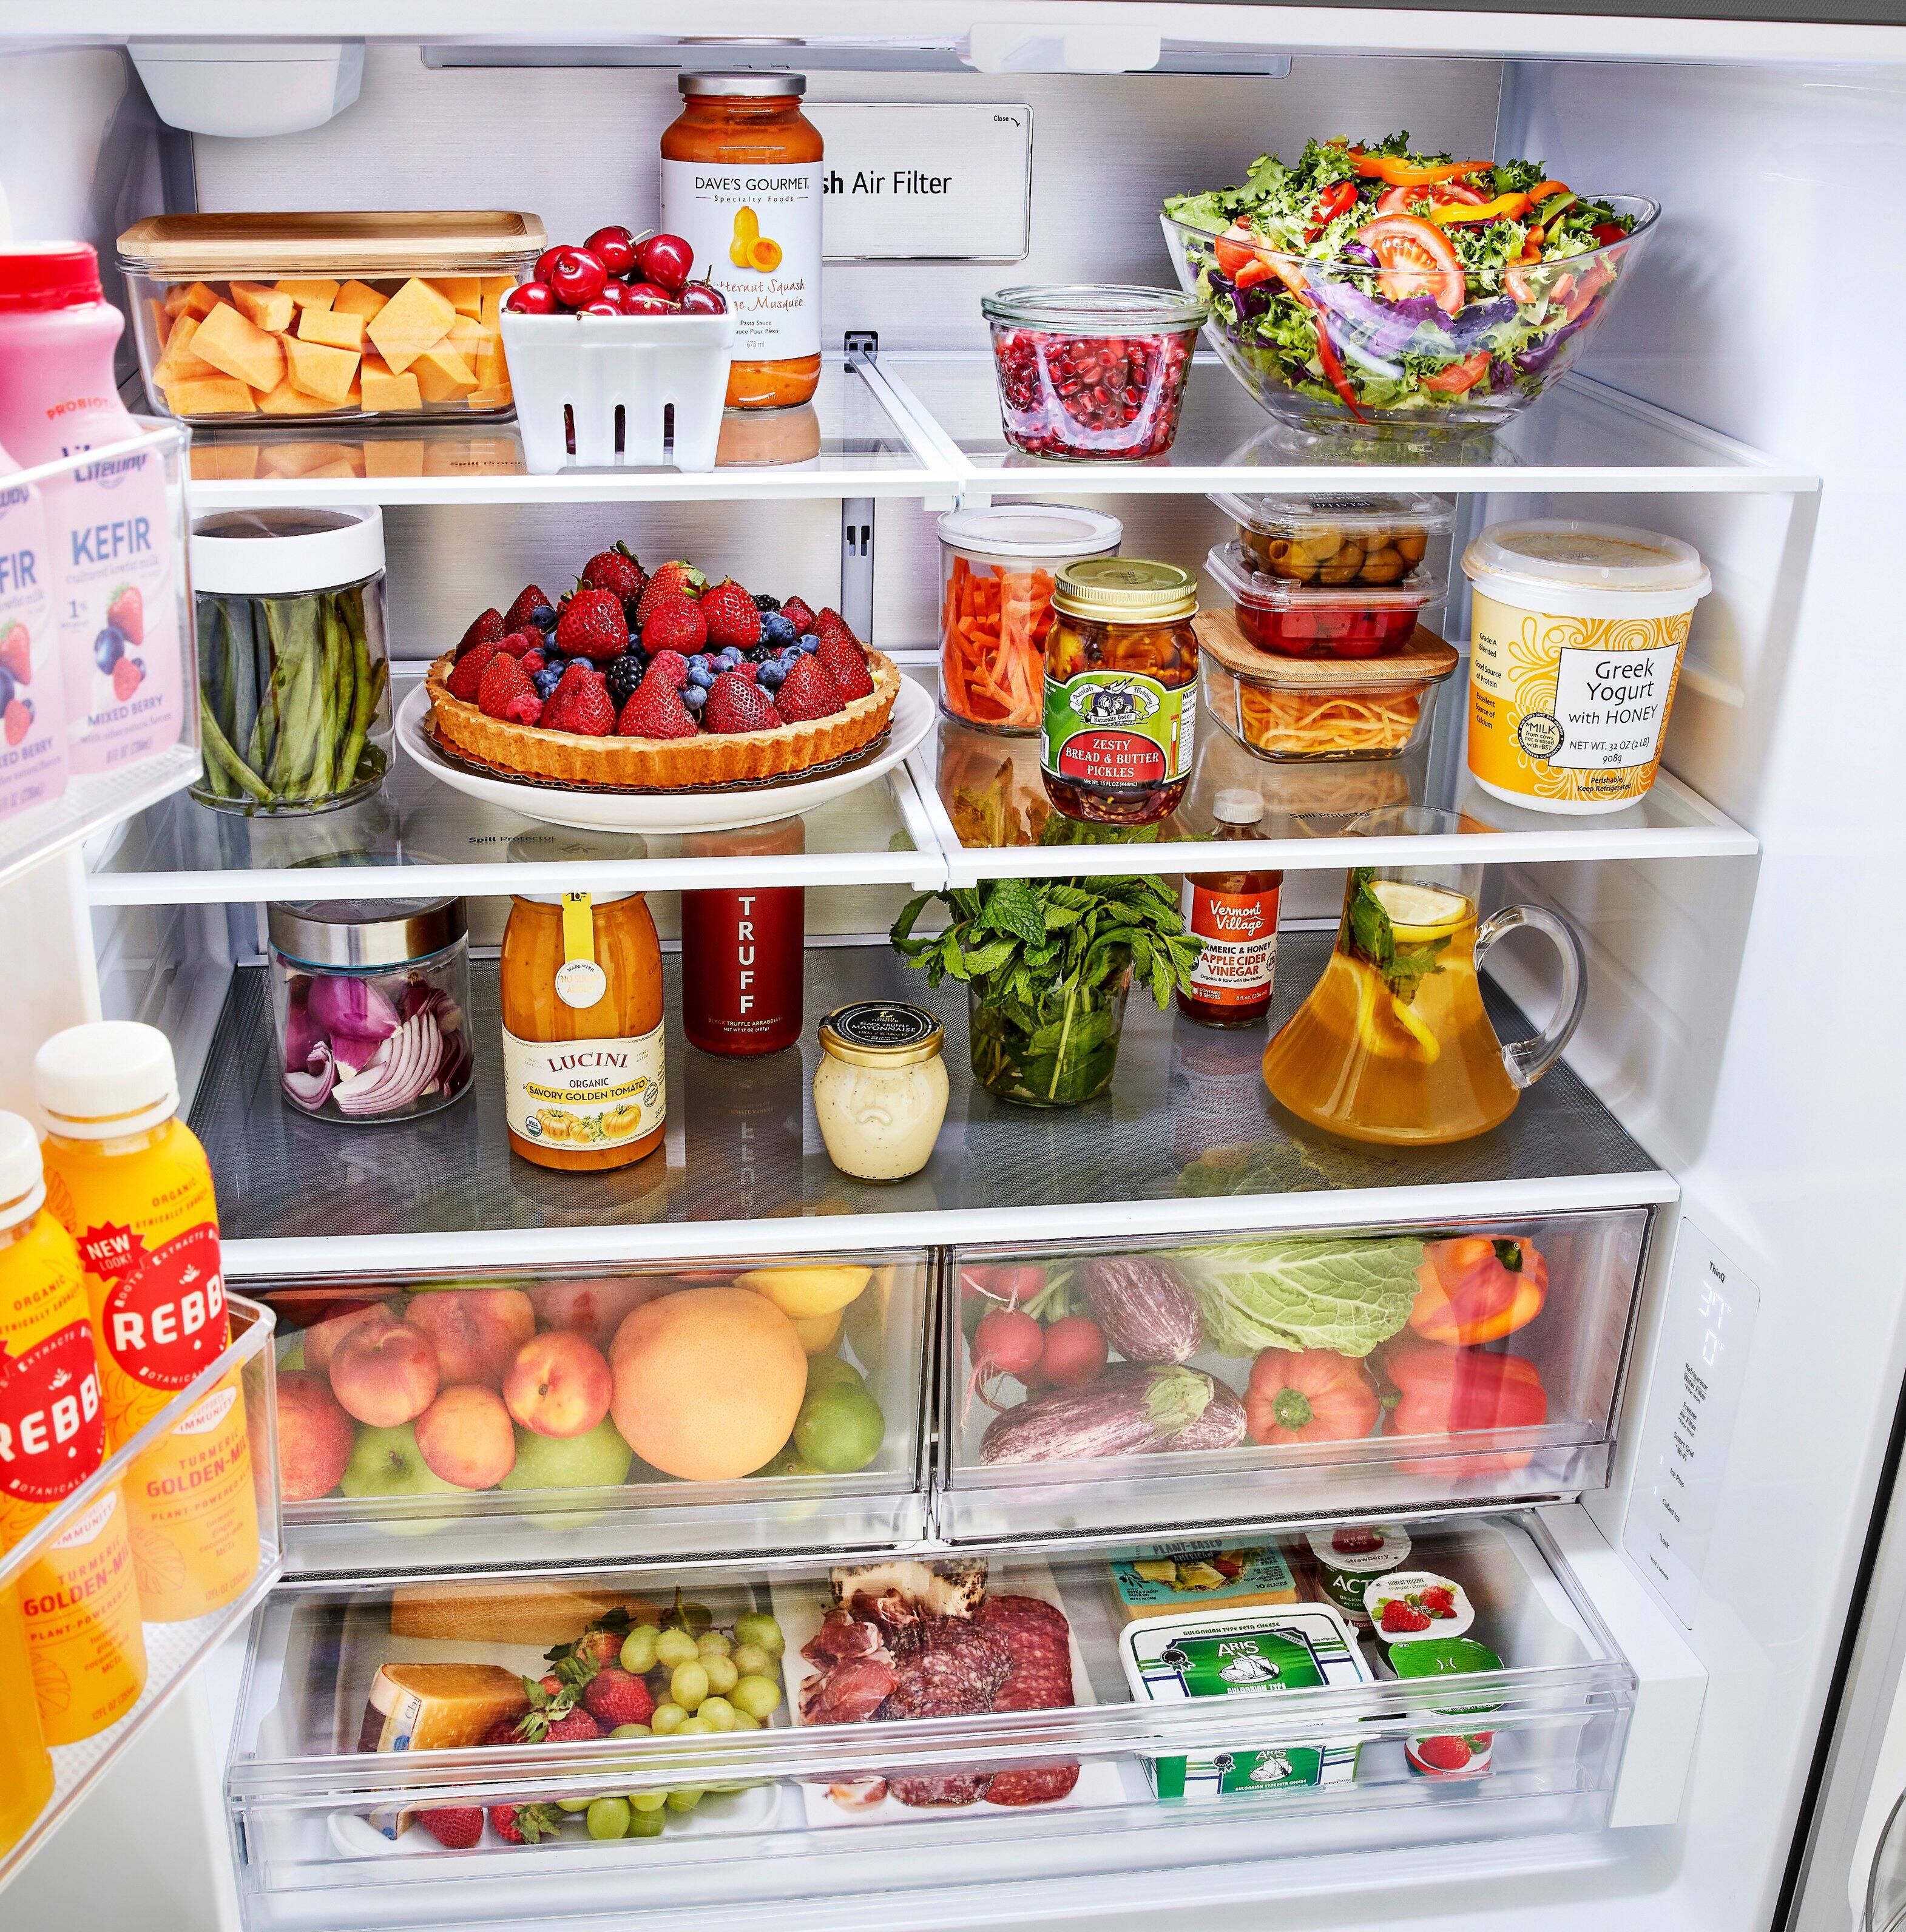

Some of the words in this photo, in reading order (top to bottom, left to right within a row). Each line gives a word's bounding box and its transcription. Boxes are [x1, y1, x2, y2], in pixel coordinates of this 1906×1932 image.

[695, 177, 742, 191] DAVE'S
[746, 177, 809, 191] GOURMET
[851, 171, 885, 194] Air
[893, 170, 953, 194] Filter
[714, 195, 762, 203] Specialty
[768, 279, 805, 296] Squash
[747, 296, 803, 312] Musquée
[71, 516, 152, 566] KEFIR
[1479, 632, 1492, 644] Grade
[1479, 643, 1496, 658] Blended
[1475, 659, 1484, 671] Good
[1484, 666, 1502, 679] Source
[1595, 657, 1655, 679] Greek
[1481, 675, 1497, 689] Protein
[1476, 691, 1496, 708] Excellent
[1586, 680, 1655, 706] Yogurt
[87, 706, 130, 728] MIXED
[131, 695, 164, 715] BERRY
[1475, 703, 1489, 716] Source
[1568, 711, 1600, 724] with
[1606, 704, 1658, 724] HONEY
[1476, 715, 1493, 729] Calcium
[21, 737, 53, 758] BERRY
[1092, 738, 1132, 751] ZESTY
[1570, 741, 1590, 750] NET
[1591, 741, 1607, 751] WT.
[1609, 743, 1618, 752] 32
[1620, 741, 1630, 749] OZ
[1631, 740, 1638, 751] (2
[1639, 737, 1650, 747] LB)
[1066, 747, 1100, 763] BREAD
[1104, 754, 1112, 764] &
[1116, 752, 1159, 764] BUTTER
[1603, 754, 1622, 764] 908g
[1087, 766, 1134, 777] PICKLES
[1595, 783, 1631, 792] Refrigerated
[1209, 899, 1262, 916] Vermont
[1215, 914, 1263, 937] Village
[737, 896, 756, 1015] TRUFF
[1246, 941, 1272, 954] HONEY
[1200, 953, 1235, 966] APPLE
[1237, 953, 1266, 966] CIDER
[567, 964, 581, 973] MADE
[581, 964, 595, 973] WITH
[1208, 964, 1259, 976] VINEGAR
[547, 1052, 628, 1073] LUCINI
[529, 1086, 563, 1099] SAVORY
[565, 1091, 608, 1101] GOLDEN
[609, 1079, 646, 1098] TOMATO
[569, 1077, 609, 1089] ORGANIC
[151, 1177, 198, 1208] ORGANIC
[135, 1207, 184, 1230] ETHICALLY
[86, 1234, 131, 1261] NEW
[151, 1231, 205, 1267] EXTRACTS
[99, 1253, 133, 1272] LOOK!
[1709, 1261, 1725, 1283] ThinQ
[13, 1275, 66, 1312] ORGANIC
[113, 1271, 144, 1309] ROOTS
[17, 1329, 75, 1373] EXTRACTS
[1685, 1363, 1708, 1391] Refrigerator
[1683, 1373, 1695, 1390] Water
[1694, 1384, 1706, 1401] Filter
[180, 1396, 234, 1431] IMMUNITY
[1683, 1401, 1697, 1420] Freezer
[1686, 1415, 1697, 1431] Filter
[178, 1427, 240, 1470] TURMERIC
[1673, 1431, 1685, 1449] Smart
[1685, 1444, 1694, 1458] Grid
[1675, 1474, 1685, 1488] Plus
[1662, 1498, 1674, 1516] Cubed
[1152, 1539, 1223, 1555] PLANT-BASED
[58, 1534, 121, 1586] TURMERIC
[1345, 1554, 1389, 1564] Strawberry
[1183, 1627, 1222, 1636] BULGARIAN
[1279, 1632, 1301, 1644] QUALITY
[1217, 1640, 1260, 1658] ARIS
[1227, 1683, 1267, 1695] BULGARIAN
[1268, 1682, 1287, 1690] TYPE
[1255, 1749, 1287, 1761] ARIS
